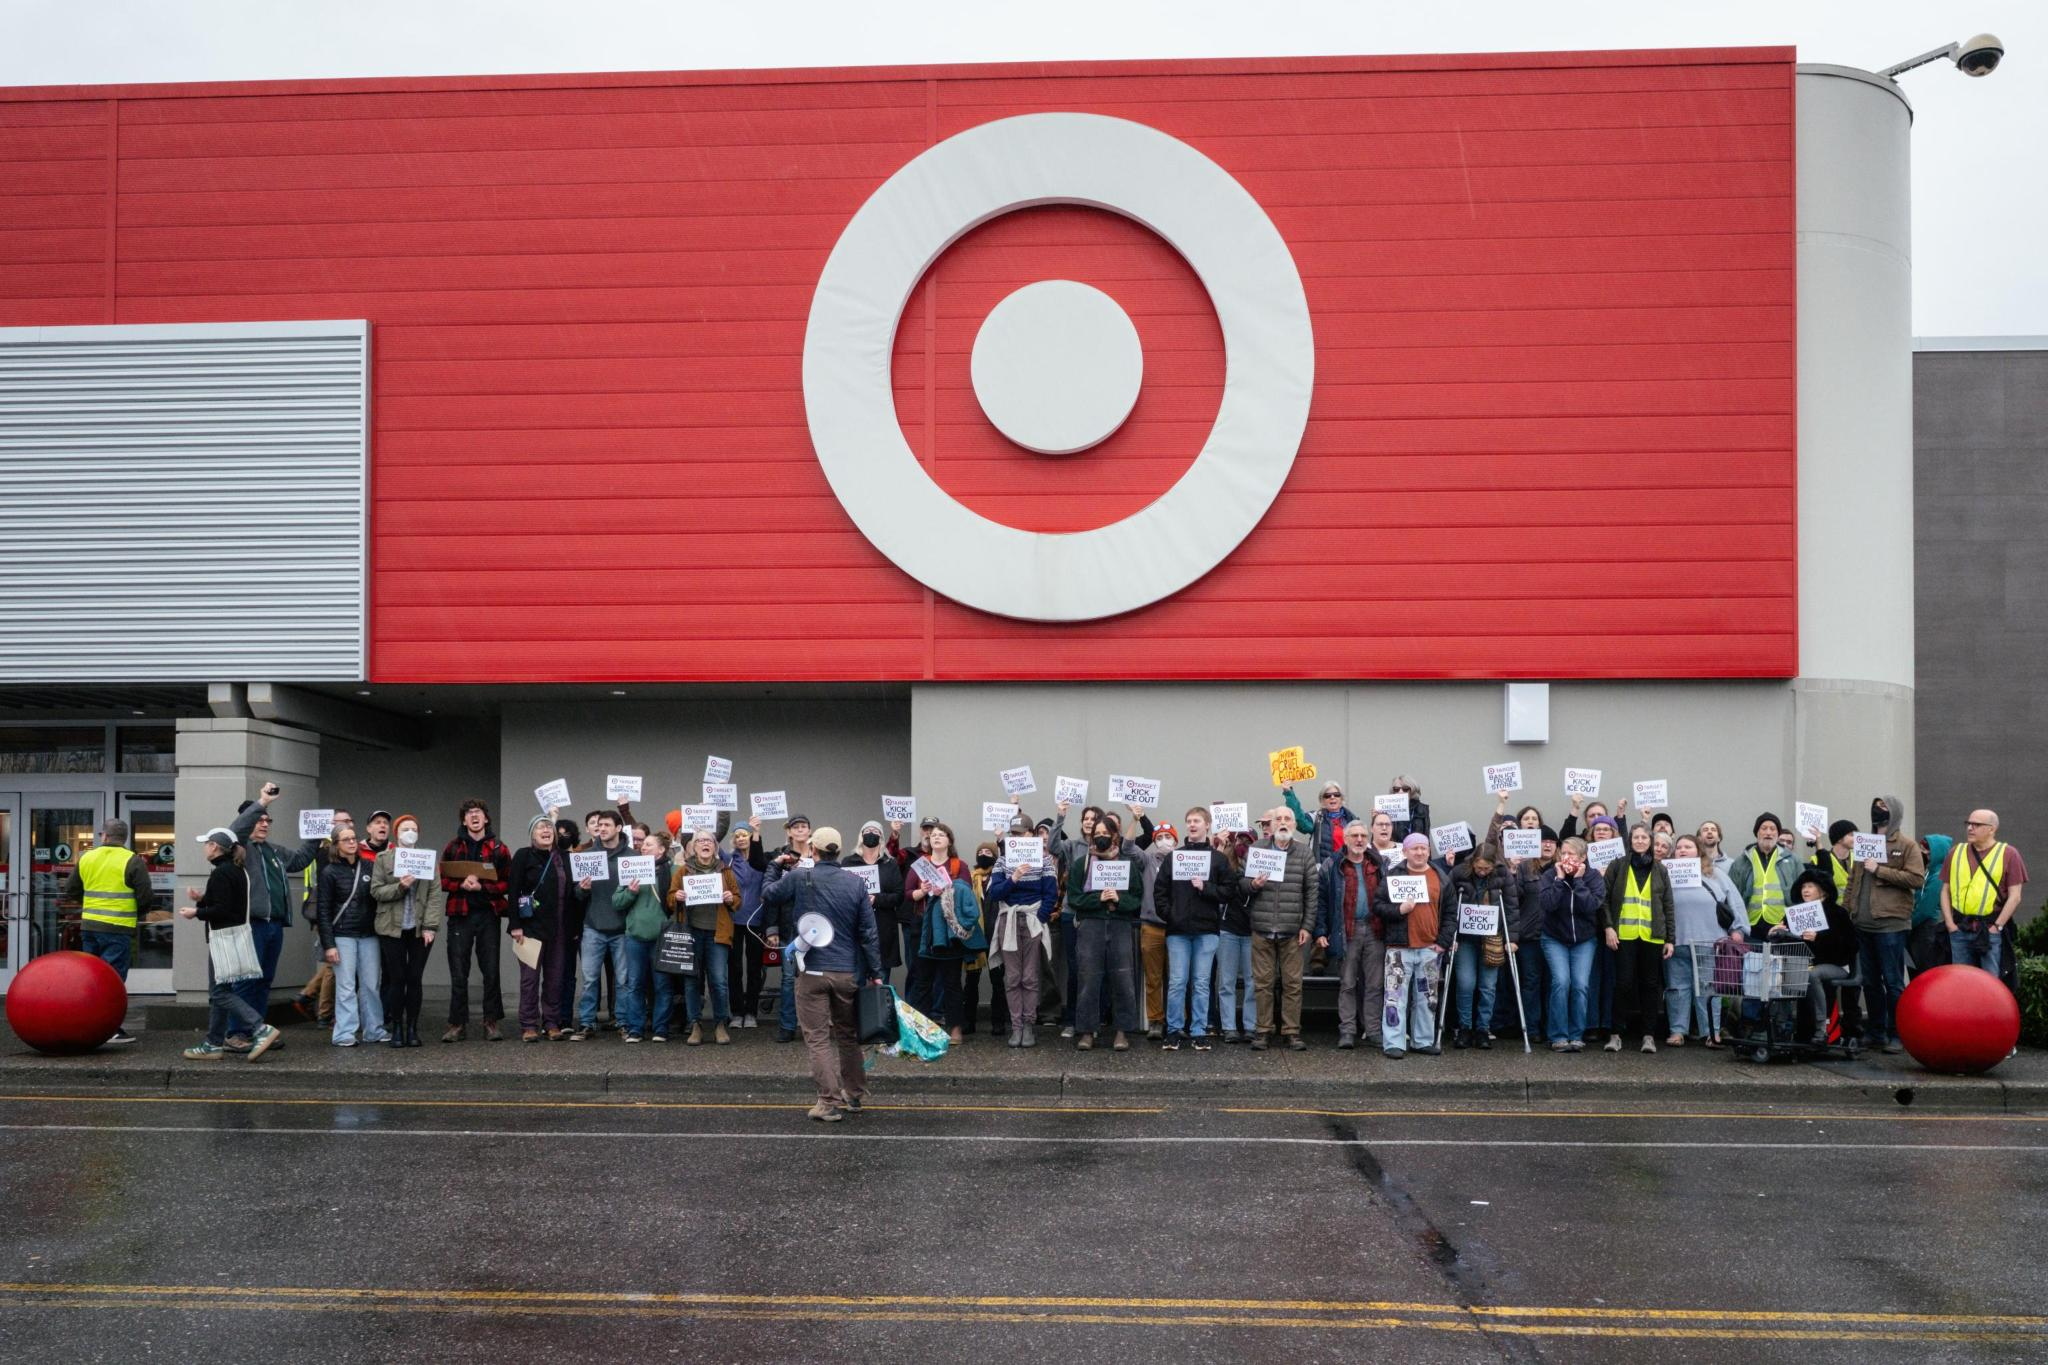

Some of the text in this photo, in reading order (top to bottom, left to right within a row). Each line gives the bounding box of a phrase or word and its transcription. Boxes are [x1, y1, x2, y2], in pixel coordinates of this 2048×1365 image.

[1131, 788, 1150, 796] KICK
[1125, 794, 1155, 803] ICE OUT
